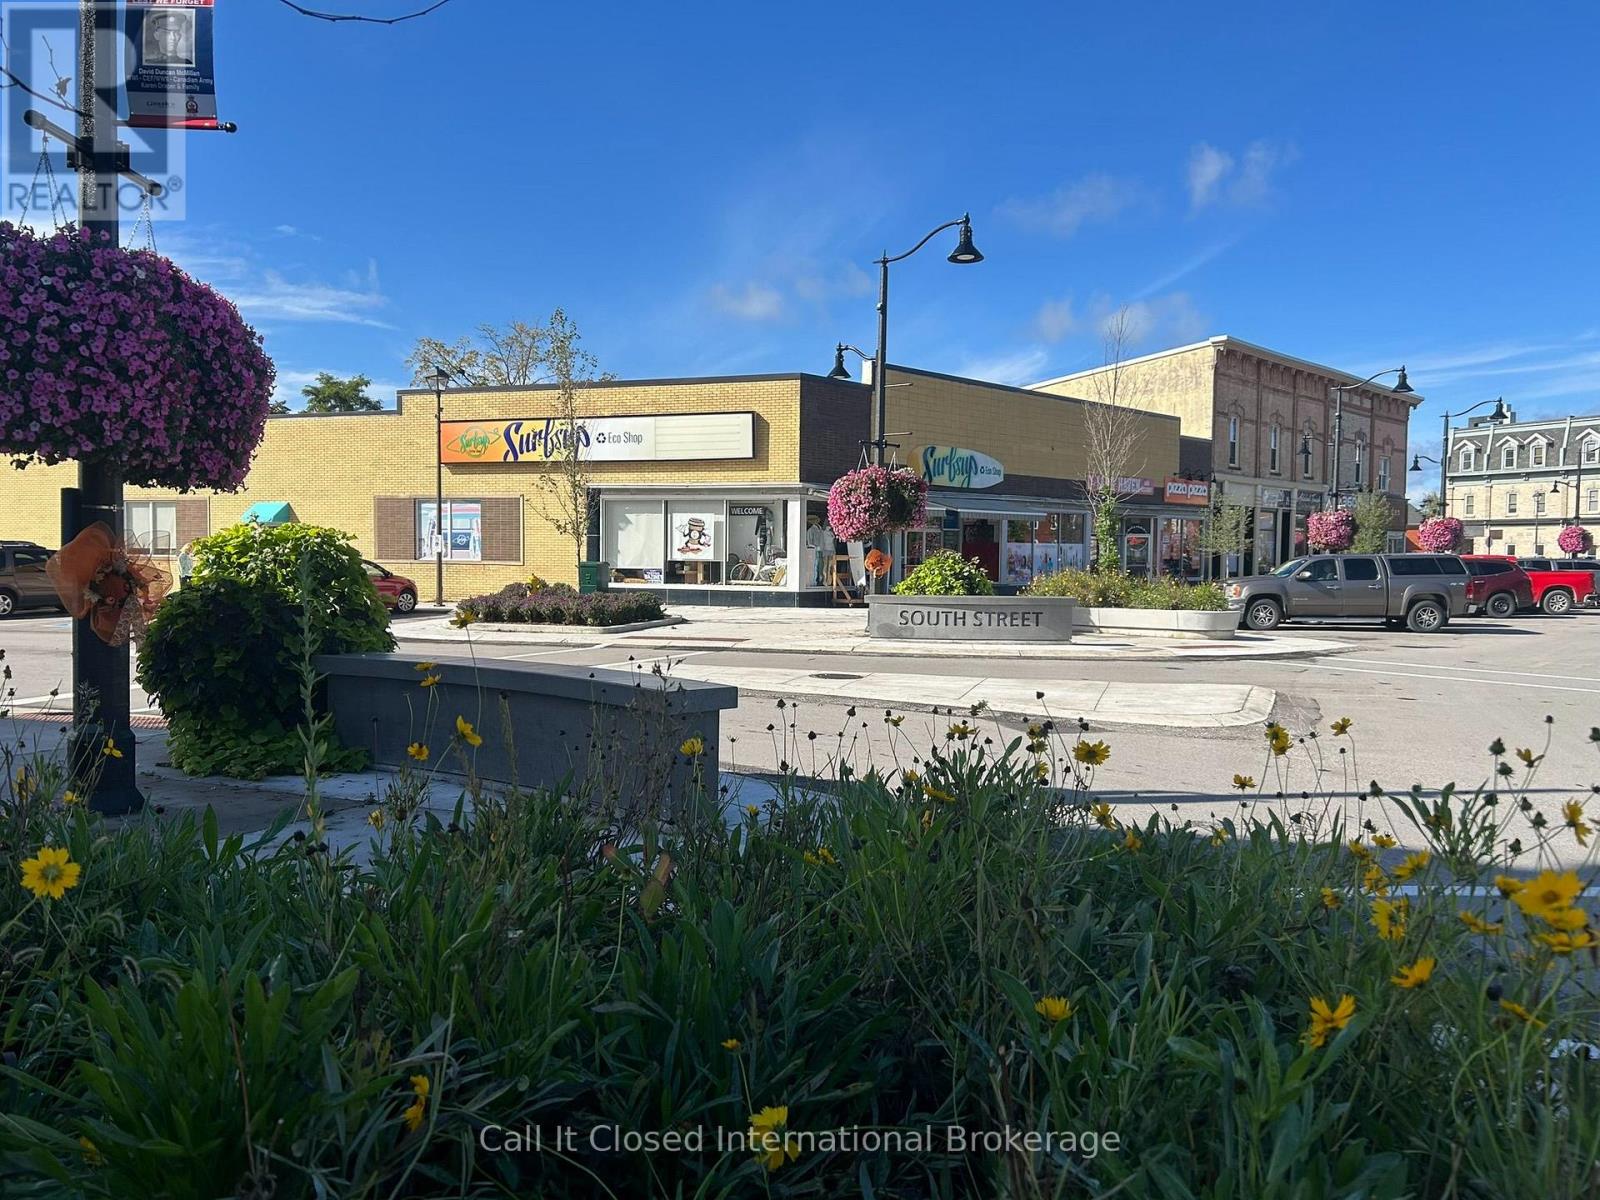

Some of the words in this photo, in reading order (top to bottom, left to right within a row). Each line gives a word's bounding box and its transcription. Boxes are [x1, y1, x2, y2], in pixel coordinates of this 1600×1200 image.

[607, 433, 622, 444] Eco
[623, 432, 643, 445] Shop
[1167, 482, 1187, 497] pizza
[1188, 483, 1207, 498] pizza
[730, 507, 763, 515] WELCOME
[899, 610, 967, 626] SOUTH
[973, 611, 1043, 627] STREET
